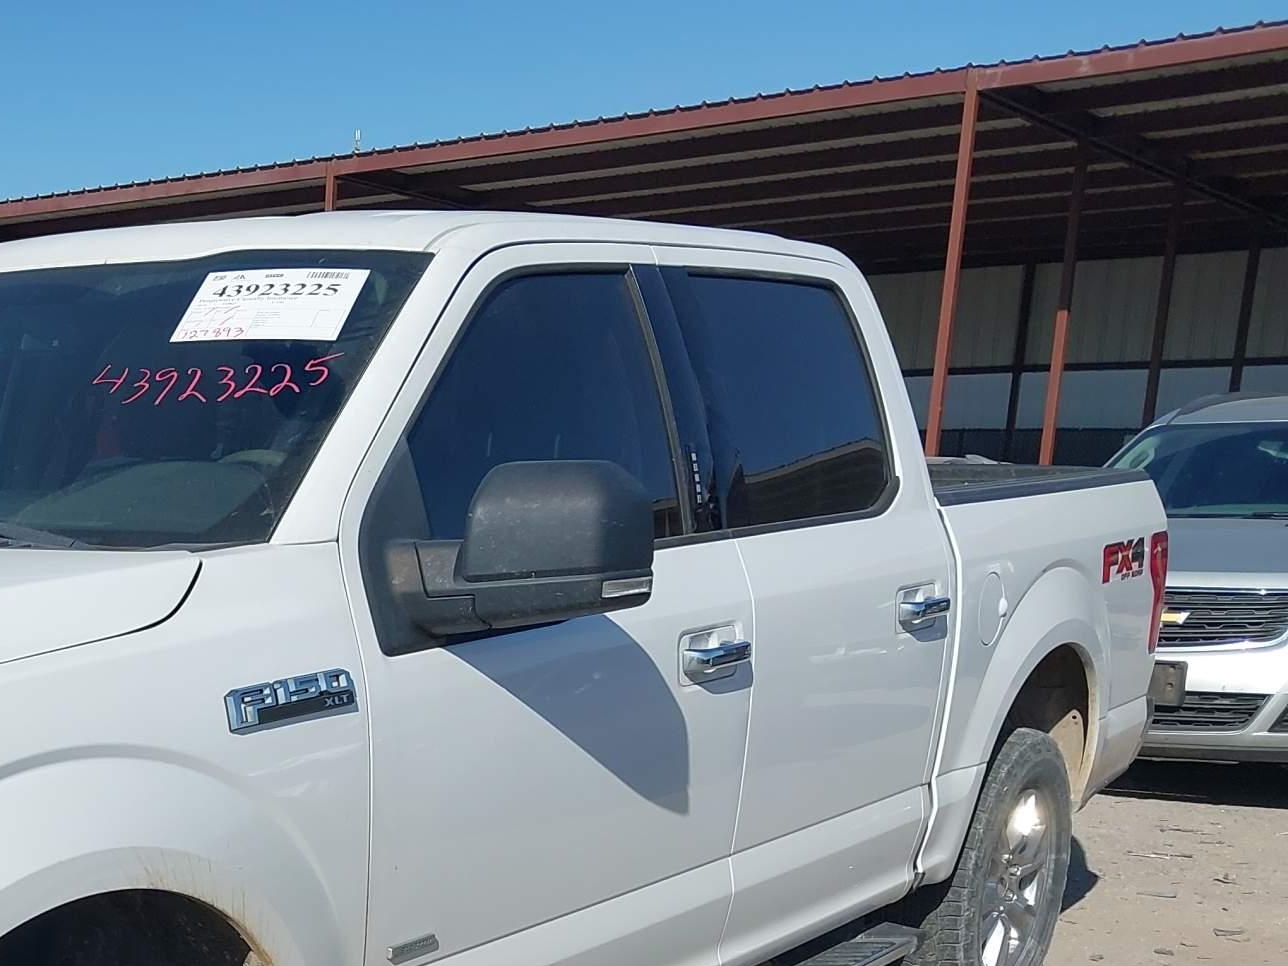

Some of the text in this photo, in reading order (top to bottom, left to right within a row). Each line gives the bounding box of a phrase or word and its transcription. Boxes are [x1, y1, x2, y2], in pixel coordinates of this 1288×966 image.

[212, 283, 343, 298] 43923225
[92, 352, 345, 405] 43923225
[1103, 537, 1144, 584] FX4
[325, 693, 349, 707] XLT
